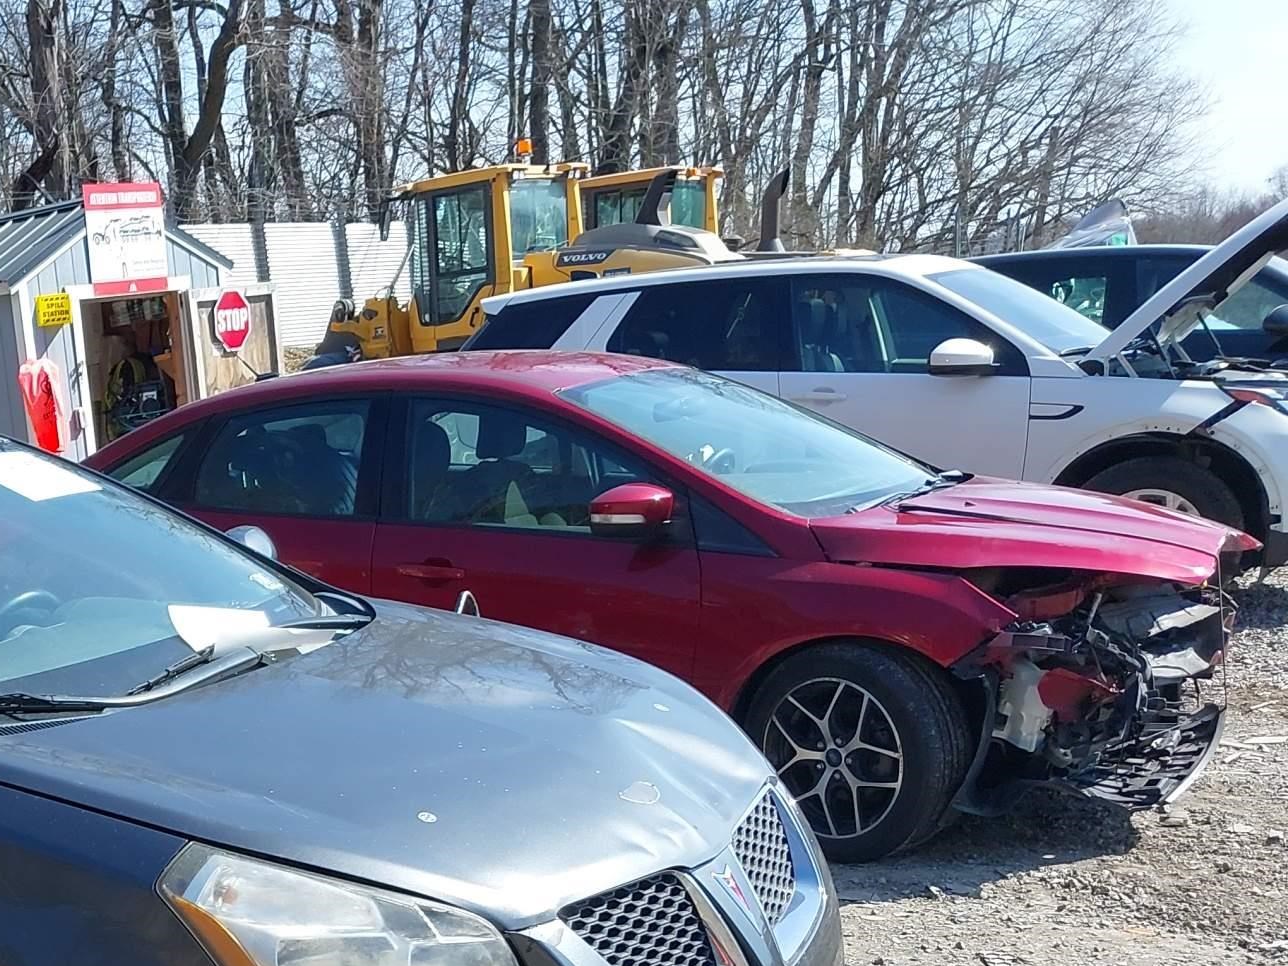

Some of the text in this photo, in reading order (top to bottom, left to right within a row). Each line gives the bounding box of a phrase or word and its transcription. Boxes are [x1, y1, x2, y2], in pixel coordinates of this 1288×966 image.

[562, 252, 607, 263] VOLVO
[46, 301, 65, 309] SPILL
[42, 309, 70, 318] STATION
[216, 307, 248, 332] STOP
